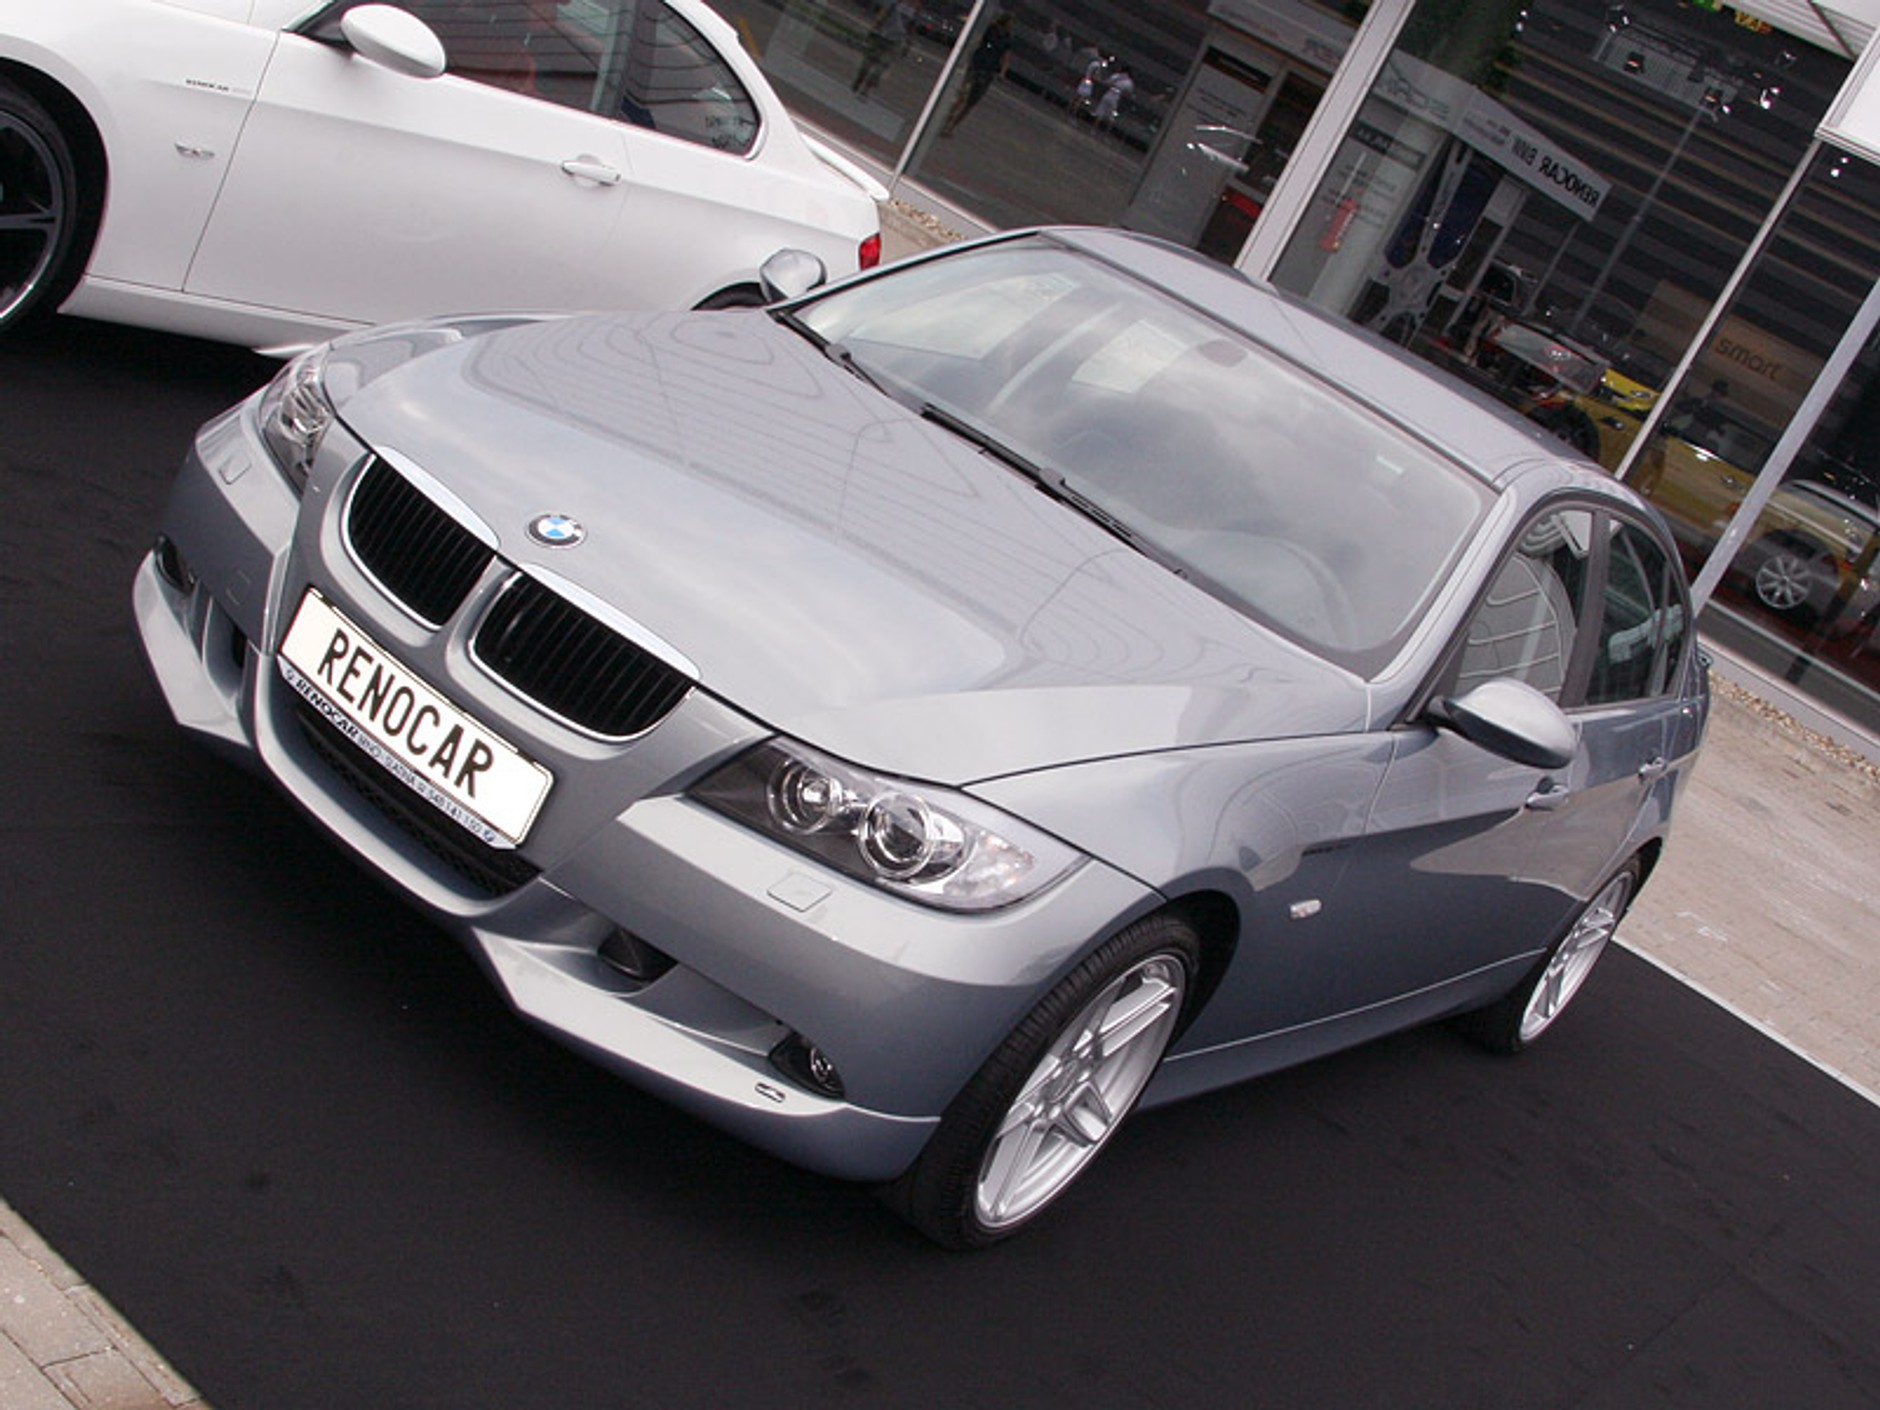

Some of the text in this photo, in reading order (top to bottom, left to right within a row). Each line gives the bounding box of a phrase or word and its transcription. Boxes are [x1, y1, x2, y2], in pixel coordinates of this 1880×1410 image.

[1715, 338, 1781, 380] smart
[298, 678, 359, 737] RENOCAR
[317, 627, 494, 799] RENOCAR
